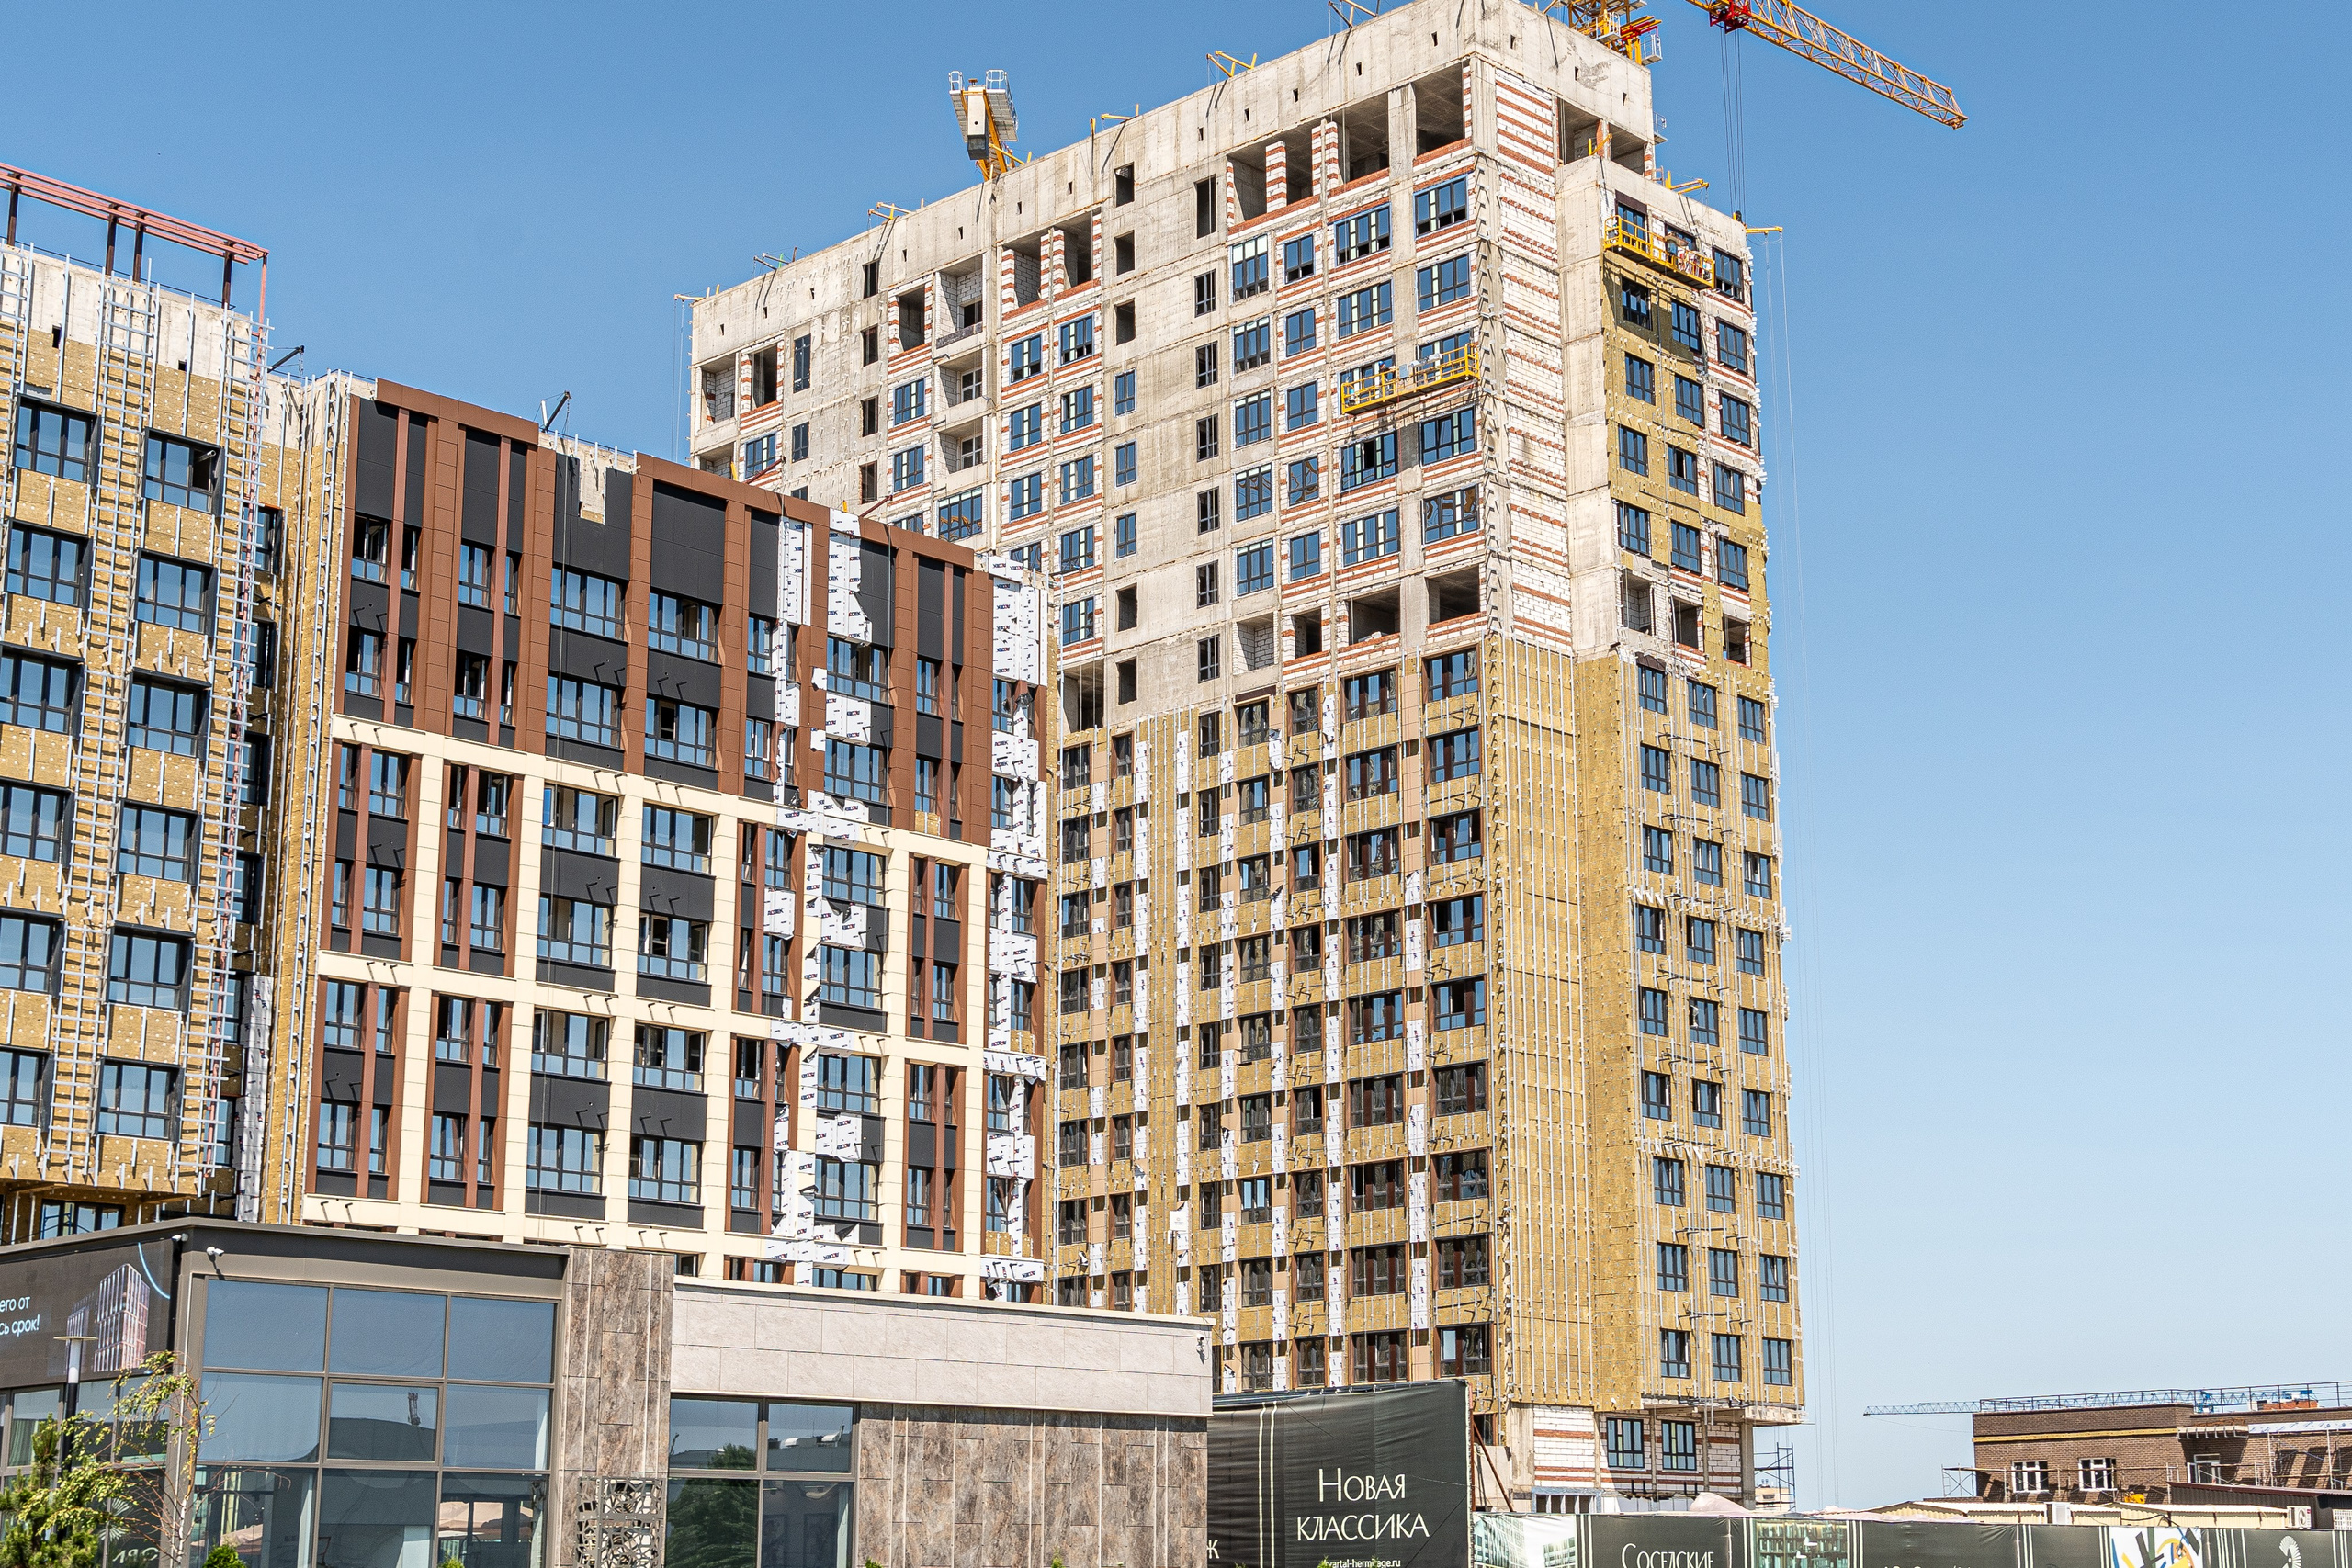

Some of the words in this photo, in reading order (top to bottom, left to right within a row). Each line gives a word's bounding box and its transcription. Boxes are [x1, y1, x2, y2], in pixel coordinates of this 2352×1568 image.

[18, 1296, 31, 1310] от
[11, 1314, 40, 1337] срок!
[1296, 1512, 1430, 1541] КЛАССИКА
